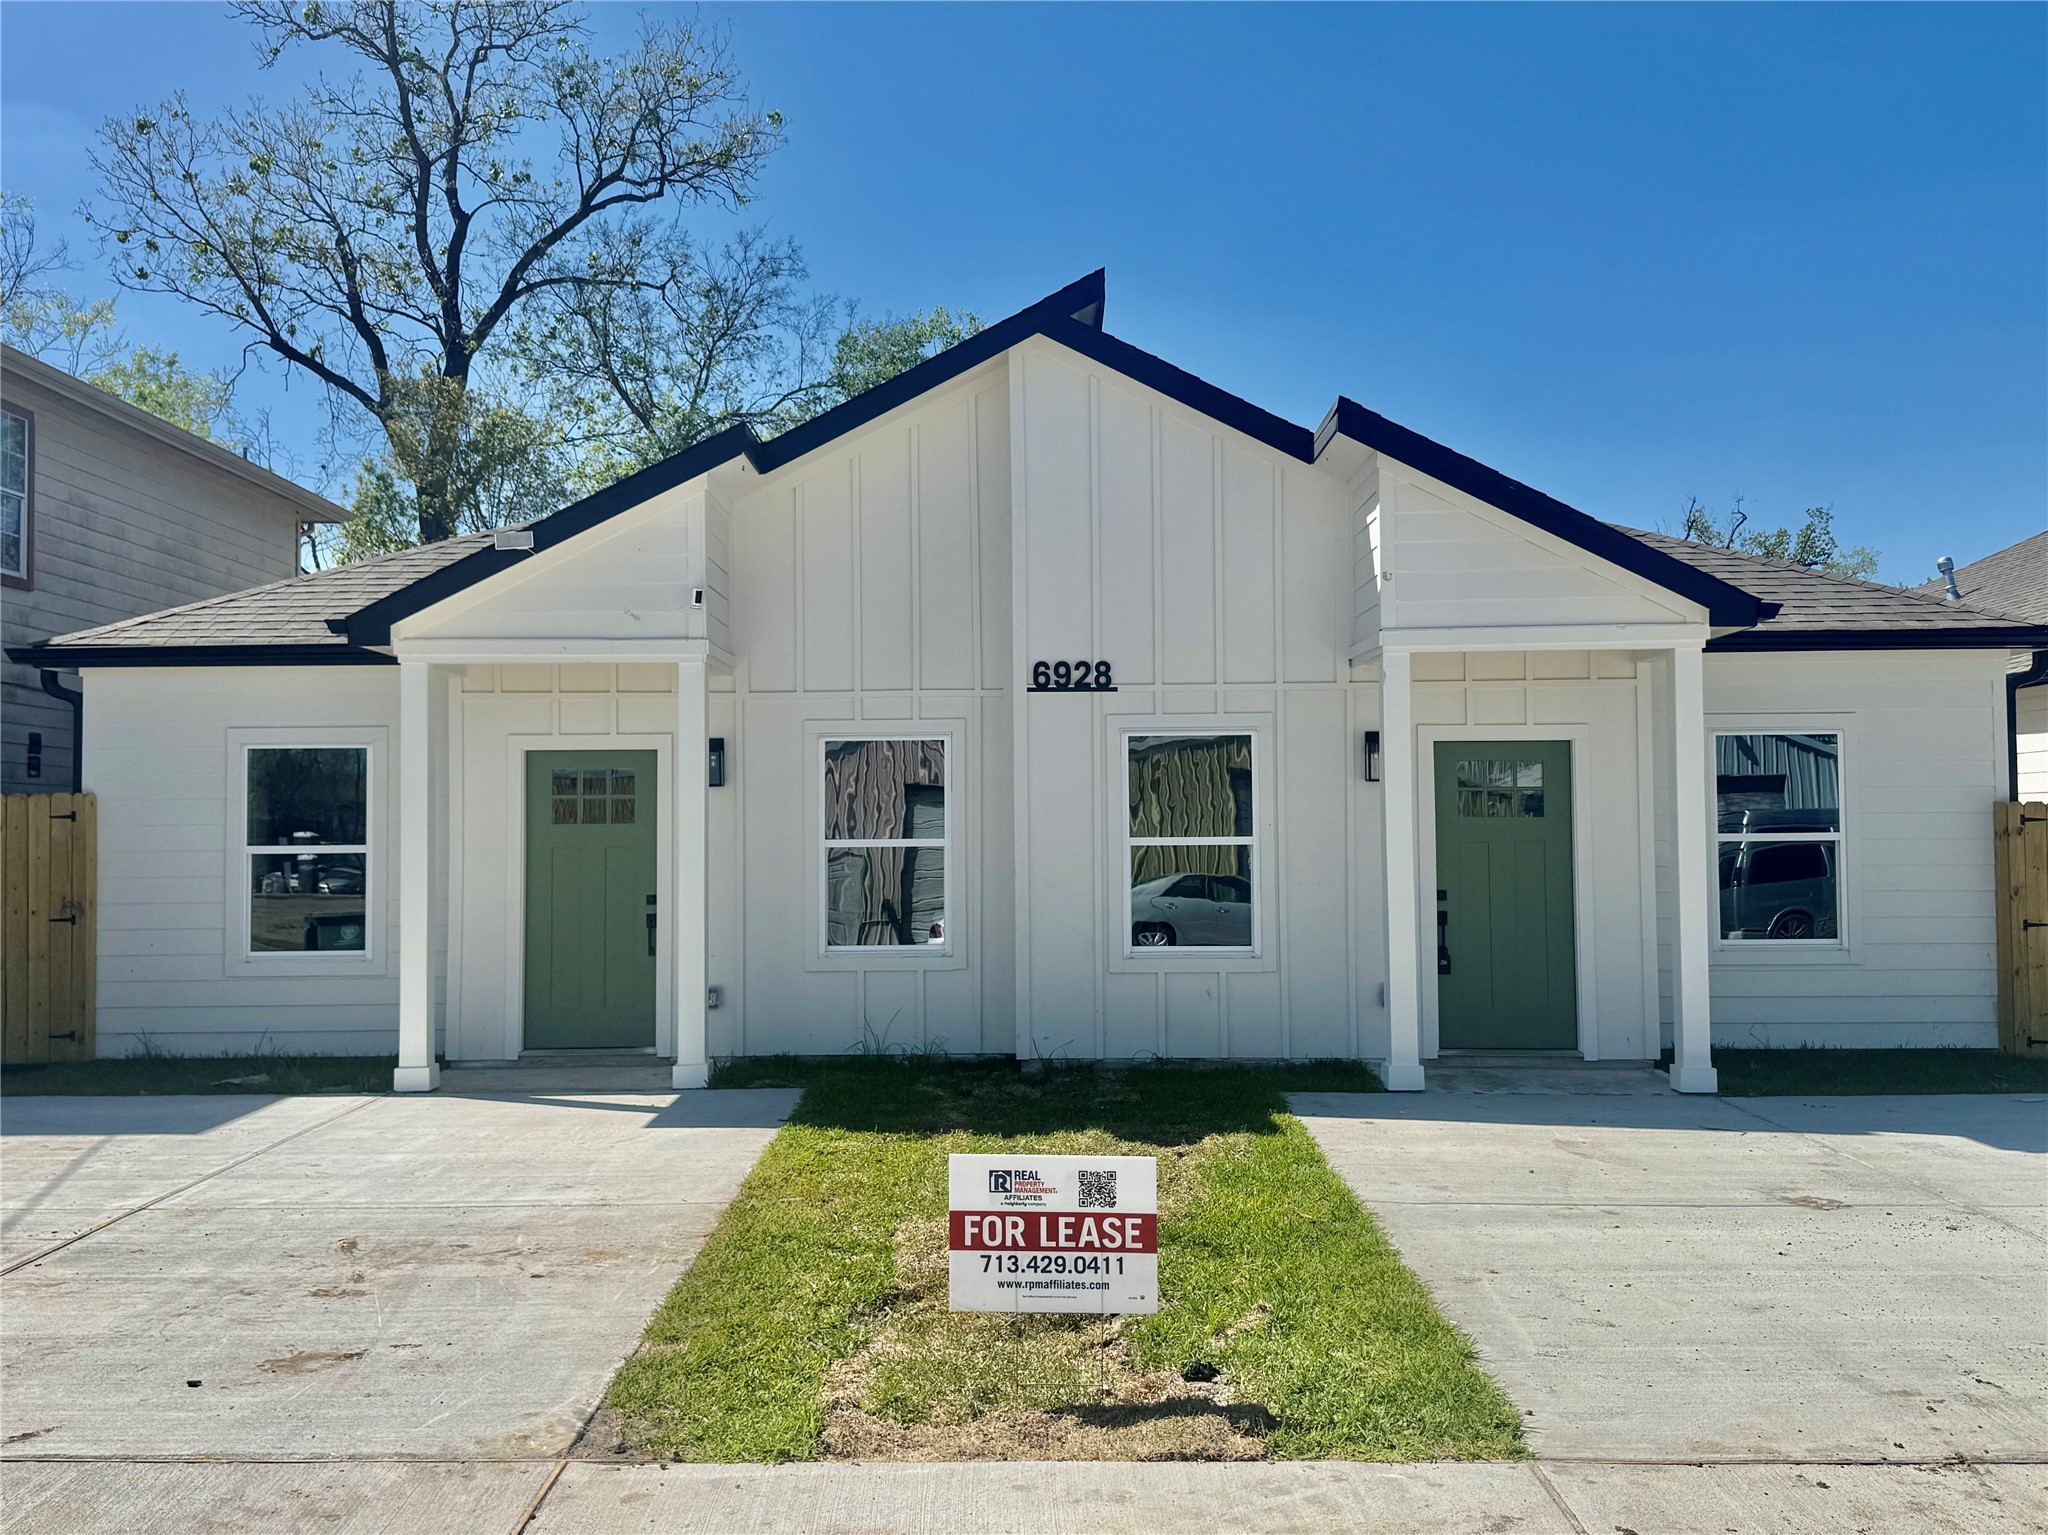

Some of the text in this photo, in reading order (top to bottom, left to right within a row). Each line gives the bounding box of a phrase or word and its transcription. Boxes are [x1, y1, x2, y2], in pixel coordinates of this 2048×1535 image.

[1033, 661, 1111, 689] 6928
[1014, 1170, 1041, 1181] REAL
[964, 1215, 1143, 1249] FOR LEASE
[980, 1255, 1124, 1275] 713.429.0411
[997, 1280, 1110, 1290] www.rpmaffiliates.com
